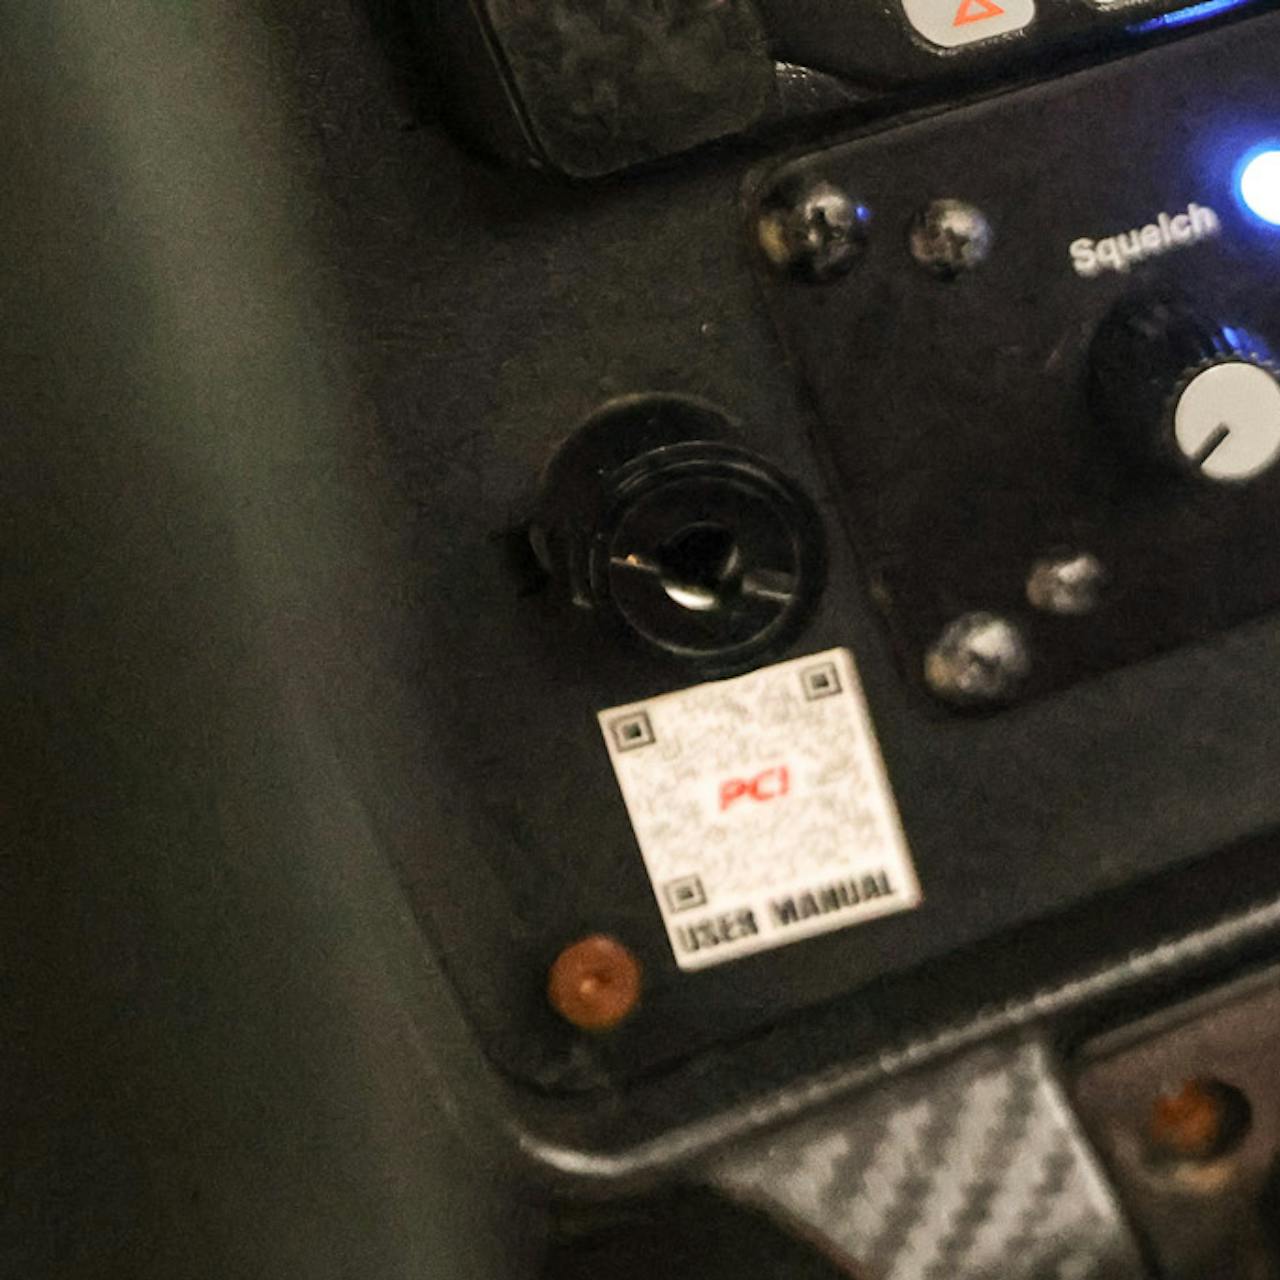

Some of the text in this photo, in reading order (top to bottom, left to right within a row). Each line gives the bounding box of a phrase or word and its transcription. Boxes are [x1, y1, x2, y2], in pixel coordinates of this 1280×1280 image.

[1069, 203, 1220, 277] Squelch
[718, 765, 790, 811] PCI
[674, 869, 899, 952] USER MANUAL
